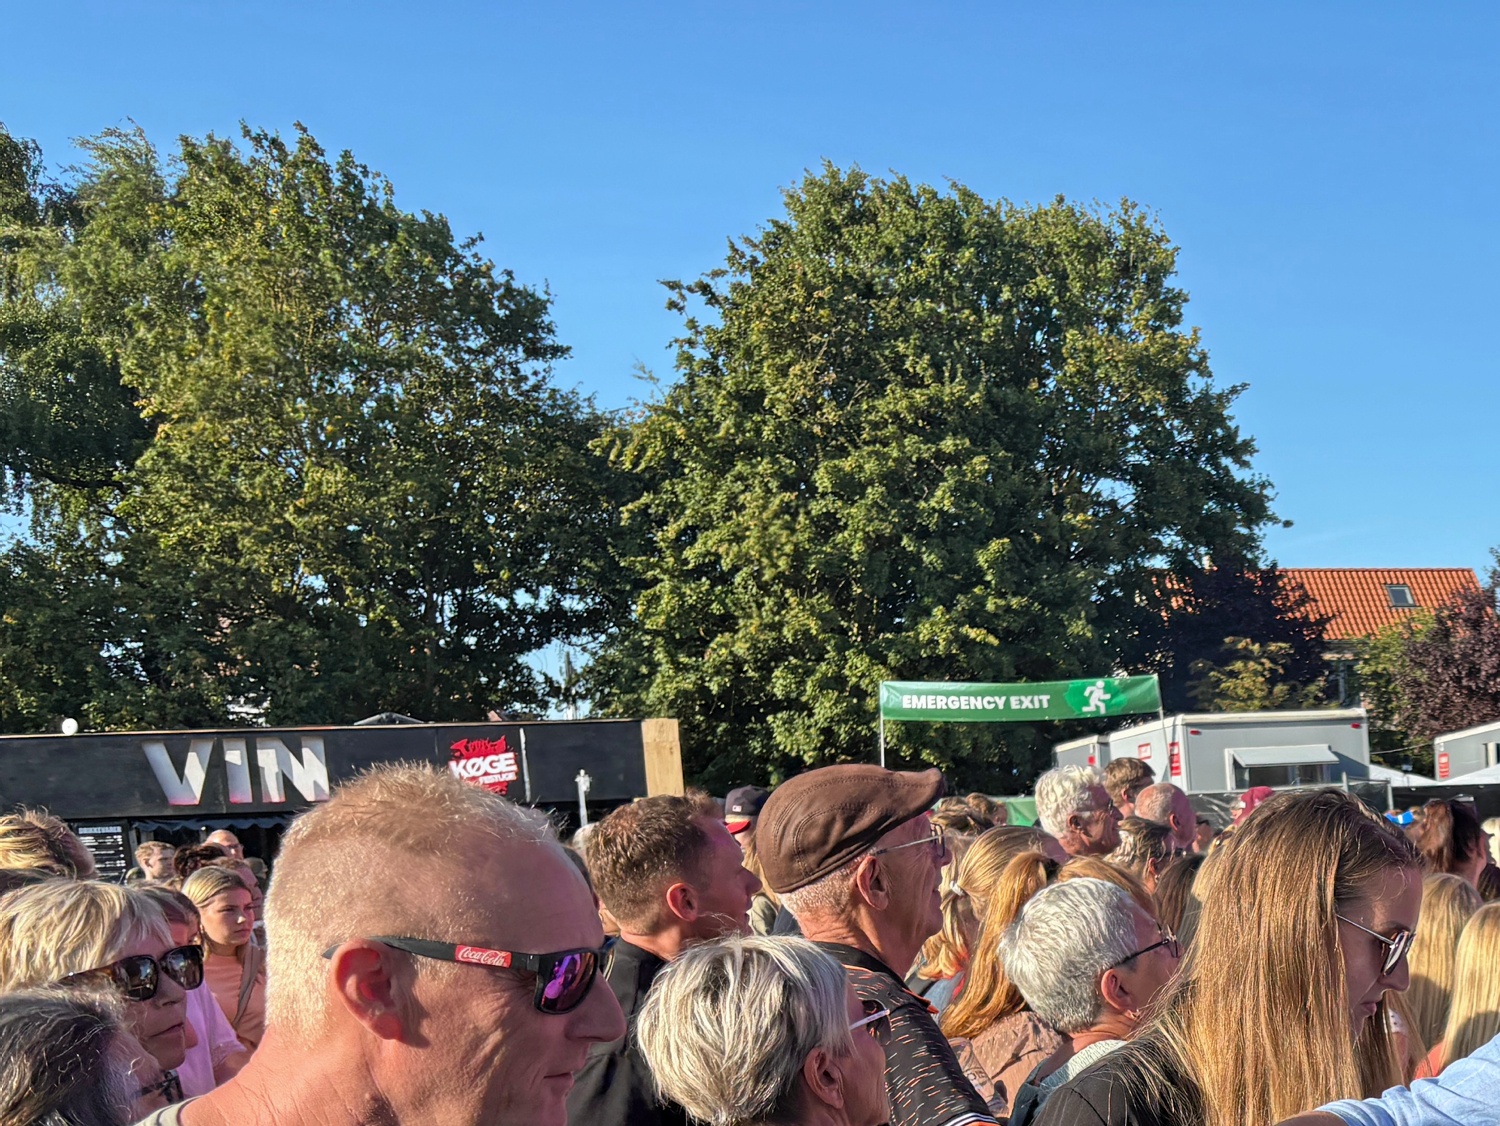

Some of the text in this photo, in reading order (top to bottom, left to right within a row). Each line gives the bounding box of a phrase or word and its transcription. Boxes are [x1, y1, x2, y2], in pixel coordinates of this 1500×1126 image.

[902, 694, 1050, 710] EMERGENCY EXIT
[141, 736, 330, 806] VIN
[448, 752, 518, 779] KØGE
